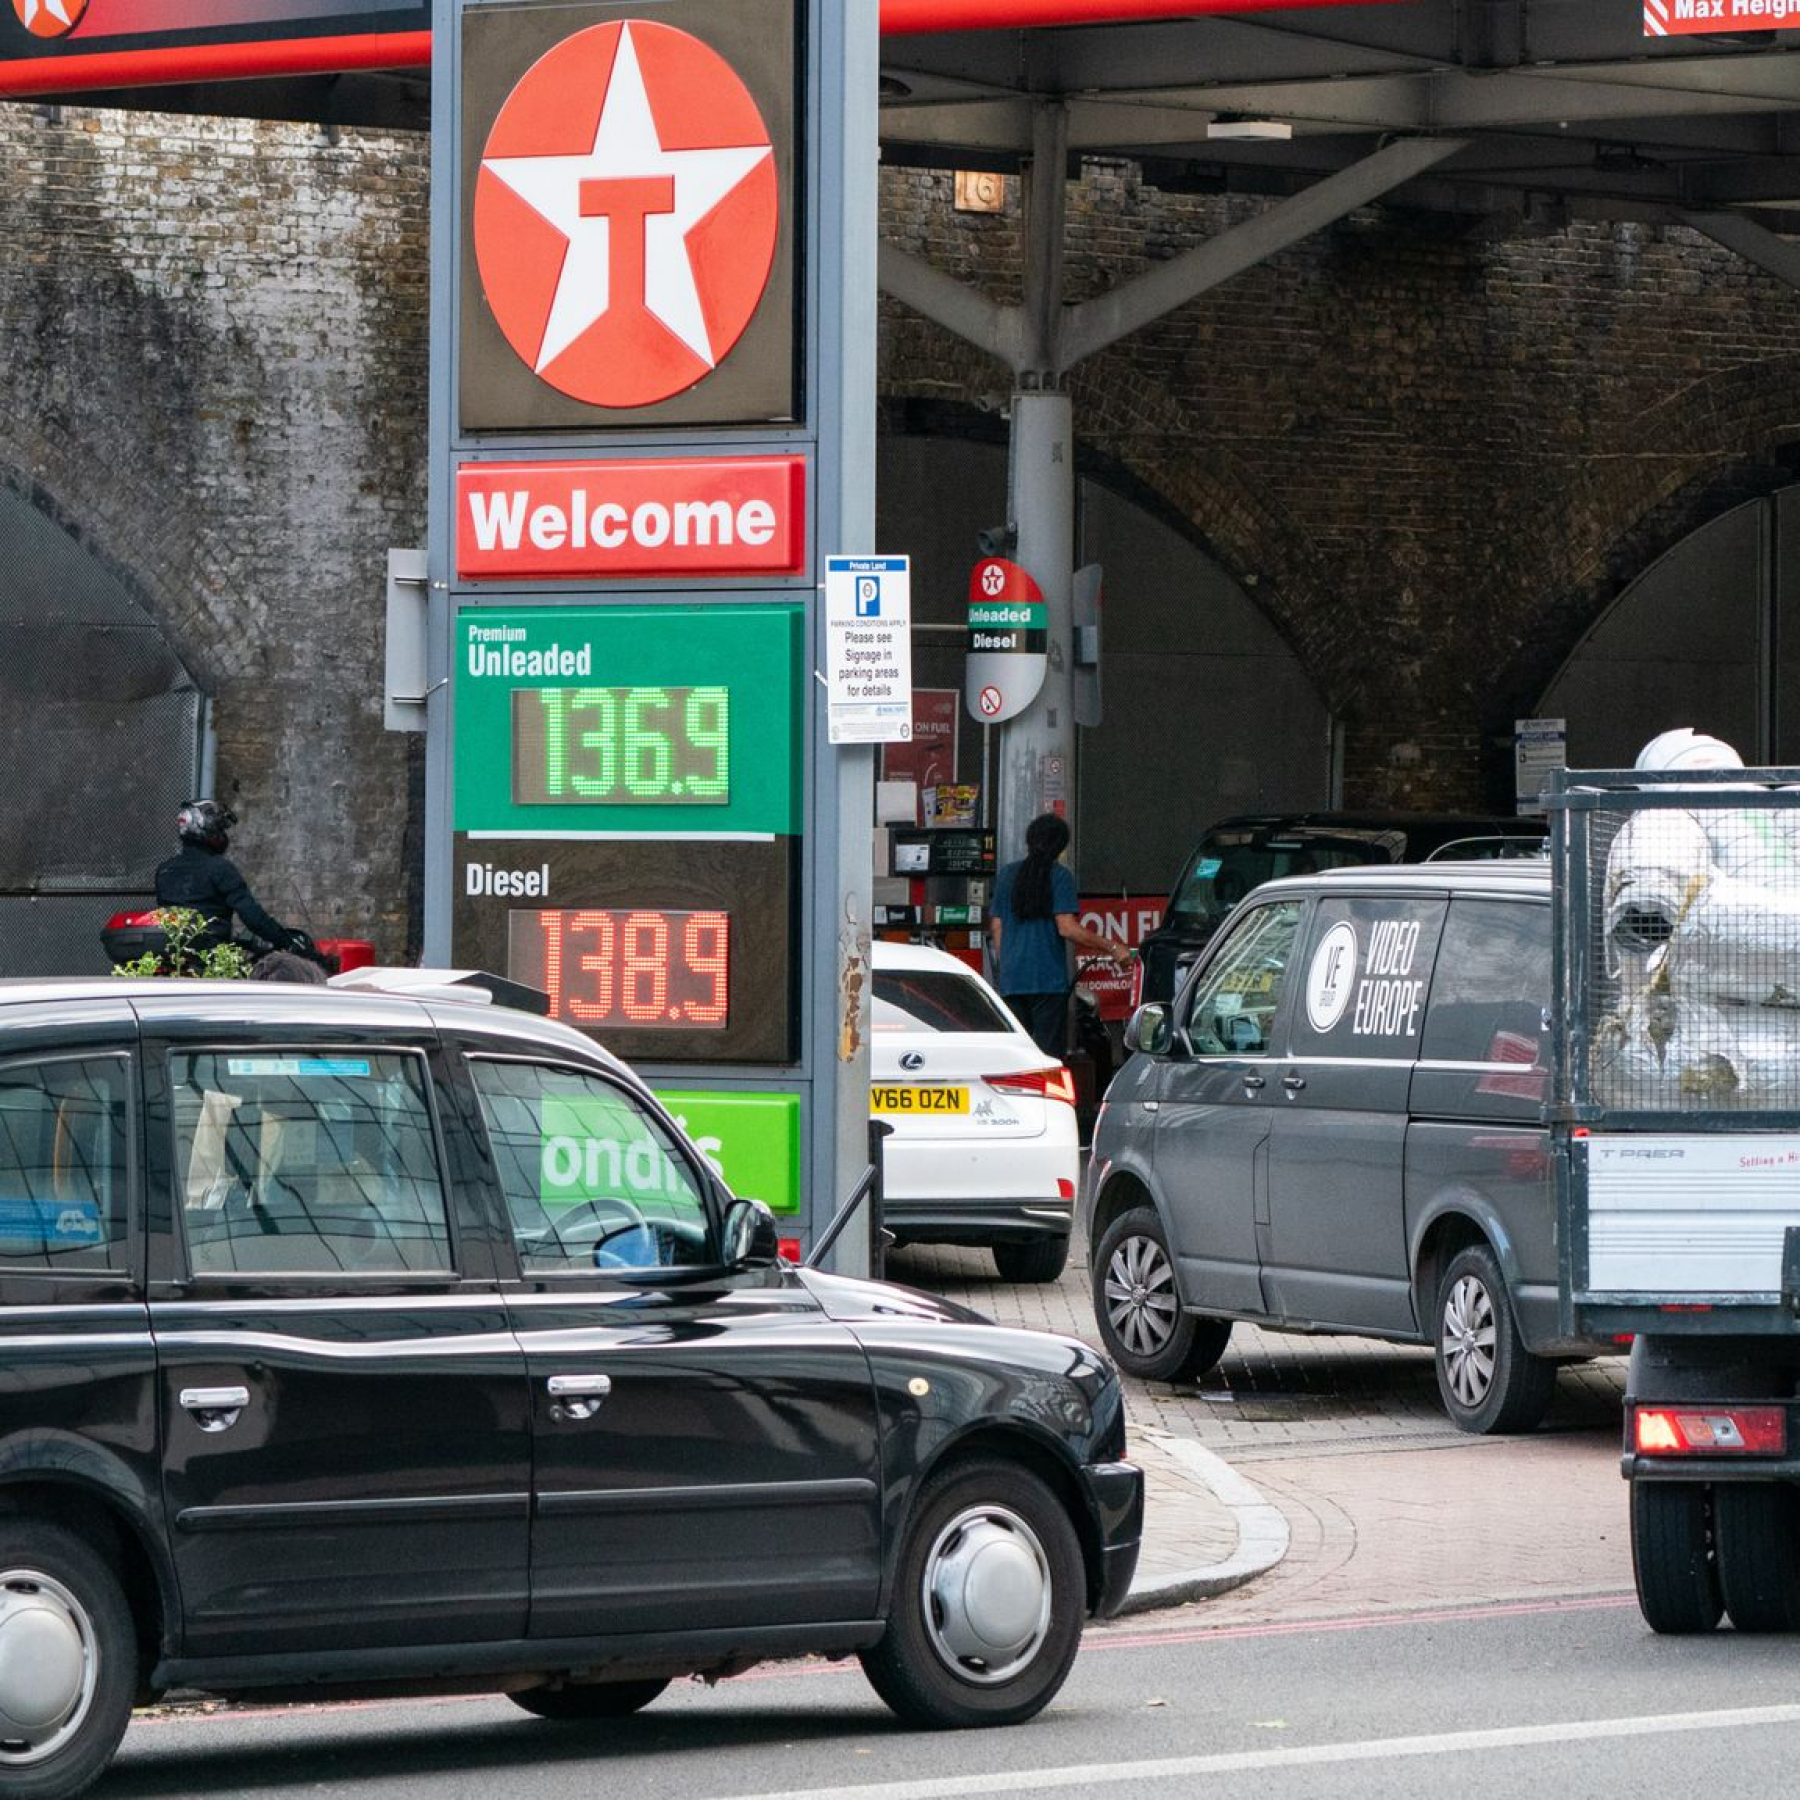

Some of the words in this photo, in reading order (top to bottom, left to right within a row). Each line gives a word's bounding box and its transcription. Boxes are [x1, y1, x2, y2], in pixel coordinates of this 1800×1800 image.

[1674, 0, 1725, 19] Max
[468, 488, 776, 551] Welcome
[468, 624, 527, 643] Premium
[844, 630, 875, 643] Please
[876, 633, 893, 643] see
[973, 632, 1017, 648] Diesel
[468, 643, 592, 677] Unleaded
[844, 648, 882, 664] Signage
[883, 648, 893, 660] in
[838, 667, 873, 681] parking
[874, 668, 899, 679] areas
[847, 684, 860, 697] for
[862, 683, 892, 697] details
[540, 687, 729, 796] 136.9
[466, 863, 550, 897] Diesel
[1081, 911, 1129, 945] ON
[1365, 920, 1421, 976] VIDEO
[540, 911, 728, 1021] 138.9
[1352, 979, 1423, 1037] EUROPE
[871, 1089, 913, 1109] V66
[919, 1089, 960, 1109] OZN
